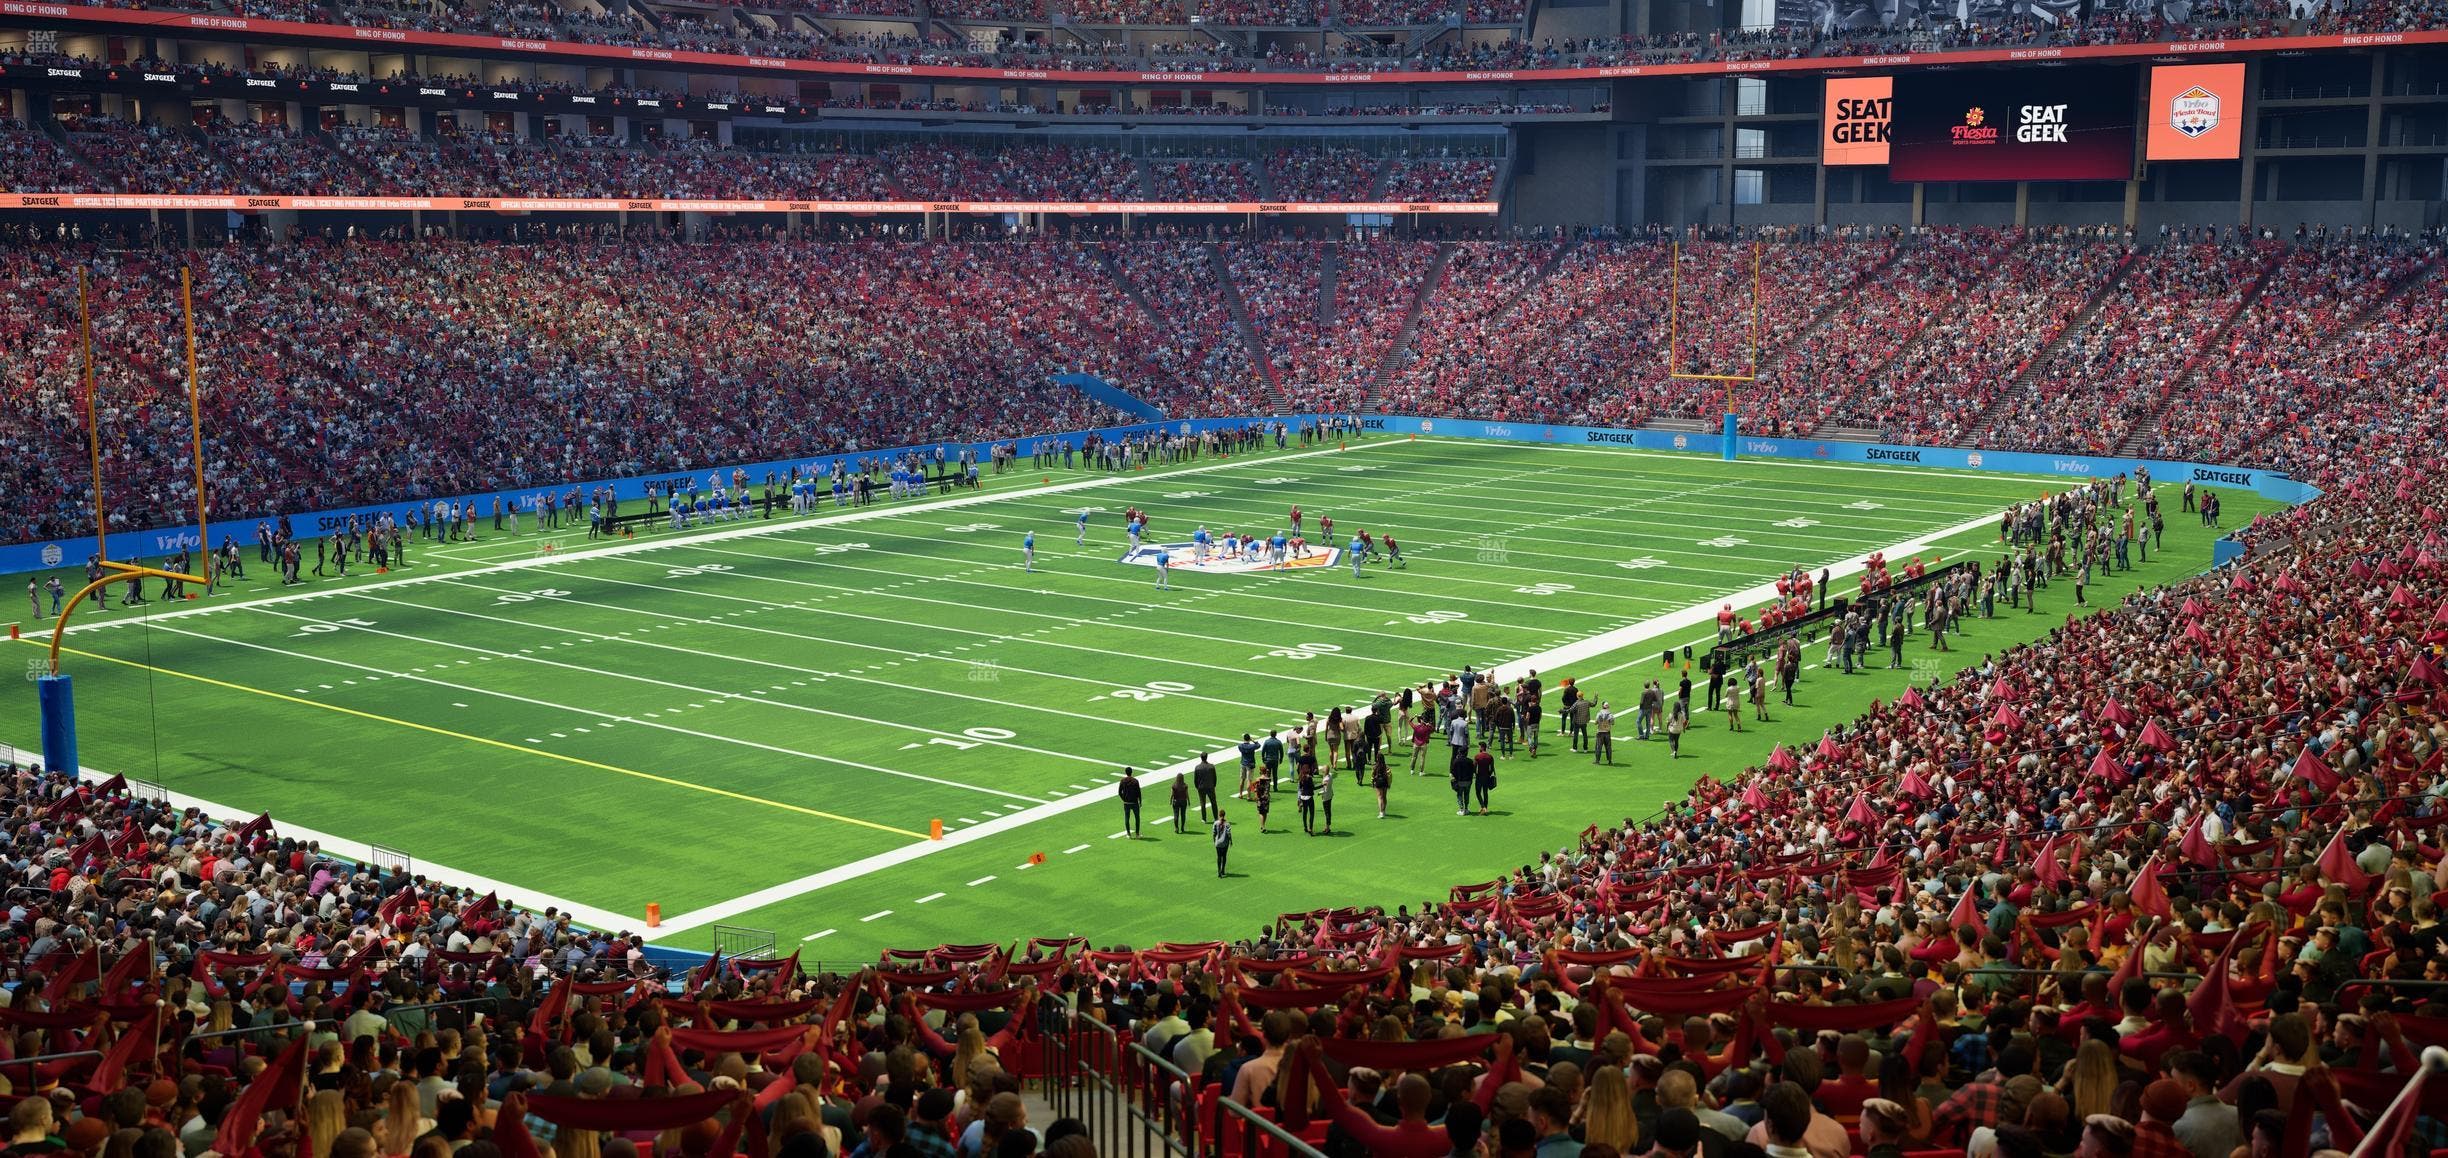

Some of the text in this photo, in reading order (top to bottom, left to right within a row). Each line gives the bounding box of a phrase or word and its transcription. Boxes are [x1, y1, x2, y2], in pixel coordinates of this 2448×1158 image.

[4, 3, 68, 16] RING OF HONOR
[191, 17, 247, 28] RING OF HONOR
[382, 32, 406, 40] HONOR
[2343, 36, 2361, 44] RING
[2188, 43, 2198, 51] OF
[2199, 42, 2225, 50] HONOR
[2010, 51, 2026, 59] RING
[48, 68, 81, 78] SEATGEEK
[144, 73, 176, 82] SEATGEEK
[246, 79, 276, 87] SEATGEEK
[330, 83, 358, 92] SEATGEEK
[420, 87, 446, 96] SEATGEEK
[1836, 98, 1892, 120] SEAT
[2183, 99, 2208, 108] Vrbo
[2020, 104, 2068, 124] SEAT
[1832, 122, 1891, 143] GEEK
[1951, 125, 1998, 139] Fiesta
[2016, 124, 2069, 143] GEEK
[22, 197, 60, 206] SEATGEEK
[73, 197, 101, 206] OFFICIAL
[102, 197, 134, 206] TICKETING
[135, 197, 163, 206] PARTNER
[163, 197, 171, 206] OF
[172, 197, 183, 206] THE
[199, 197, 219, 206] FIESTA
[248, 199, 280, 207] SEATGEEK
[463, 200, 491, 208] SEATGEEK
[1485, 425, 1511, 436] Vrbo
[1587, 432, 1634, 444] SEATGEEK
[1747, 441, 1778, 453] Vrbo
[1866, 448, 1920, 462] SEATGEEK
[2053, 460, 2090, 472] Vrbo
[2193, 468, 2252, 486] SEATGEEK
[643, 476, 693, 493] SEATEEK
[318, 510, 381, 531] SEATEEK
[156, 532, 201, 551] Vrbo
[1512, 582, 1575, 595] 50
[1405, 610, 1469, 624] 40
[1268, 643, 1343, 659] 30
[1110, 681, 1195, 701] 20
[928, 727, 1017, 750] 10
